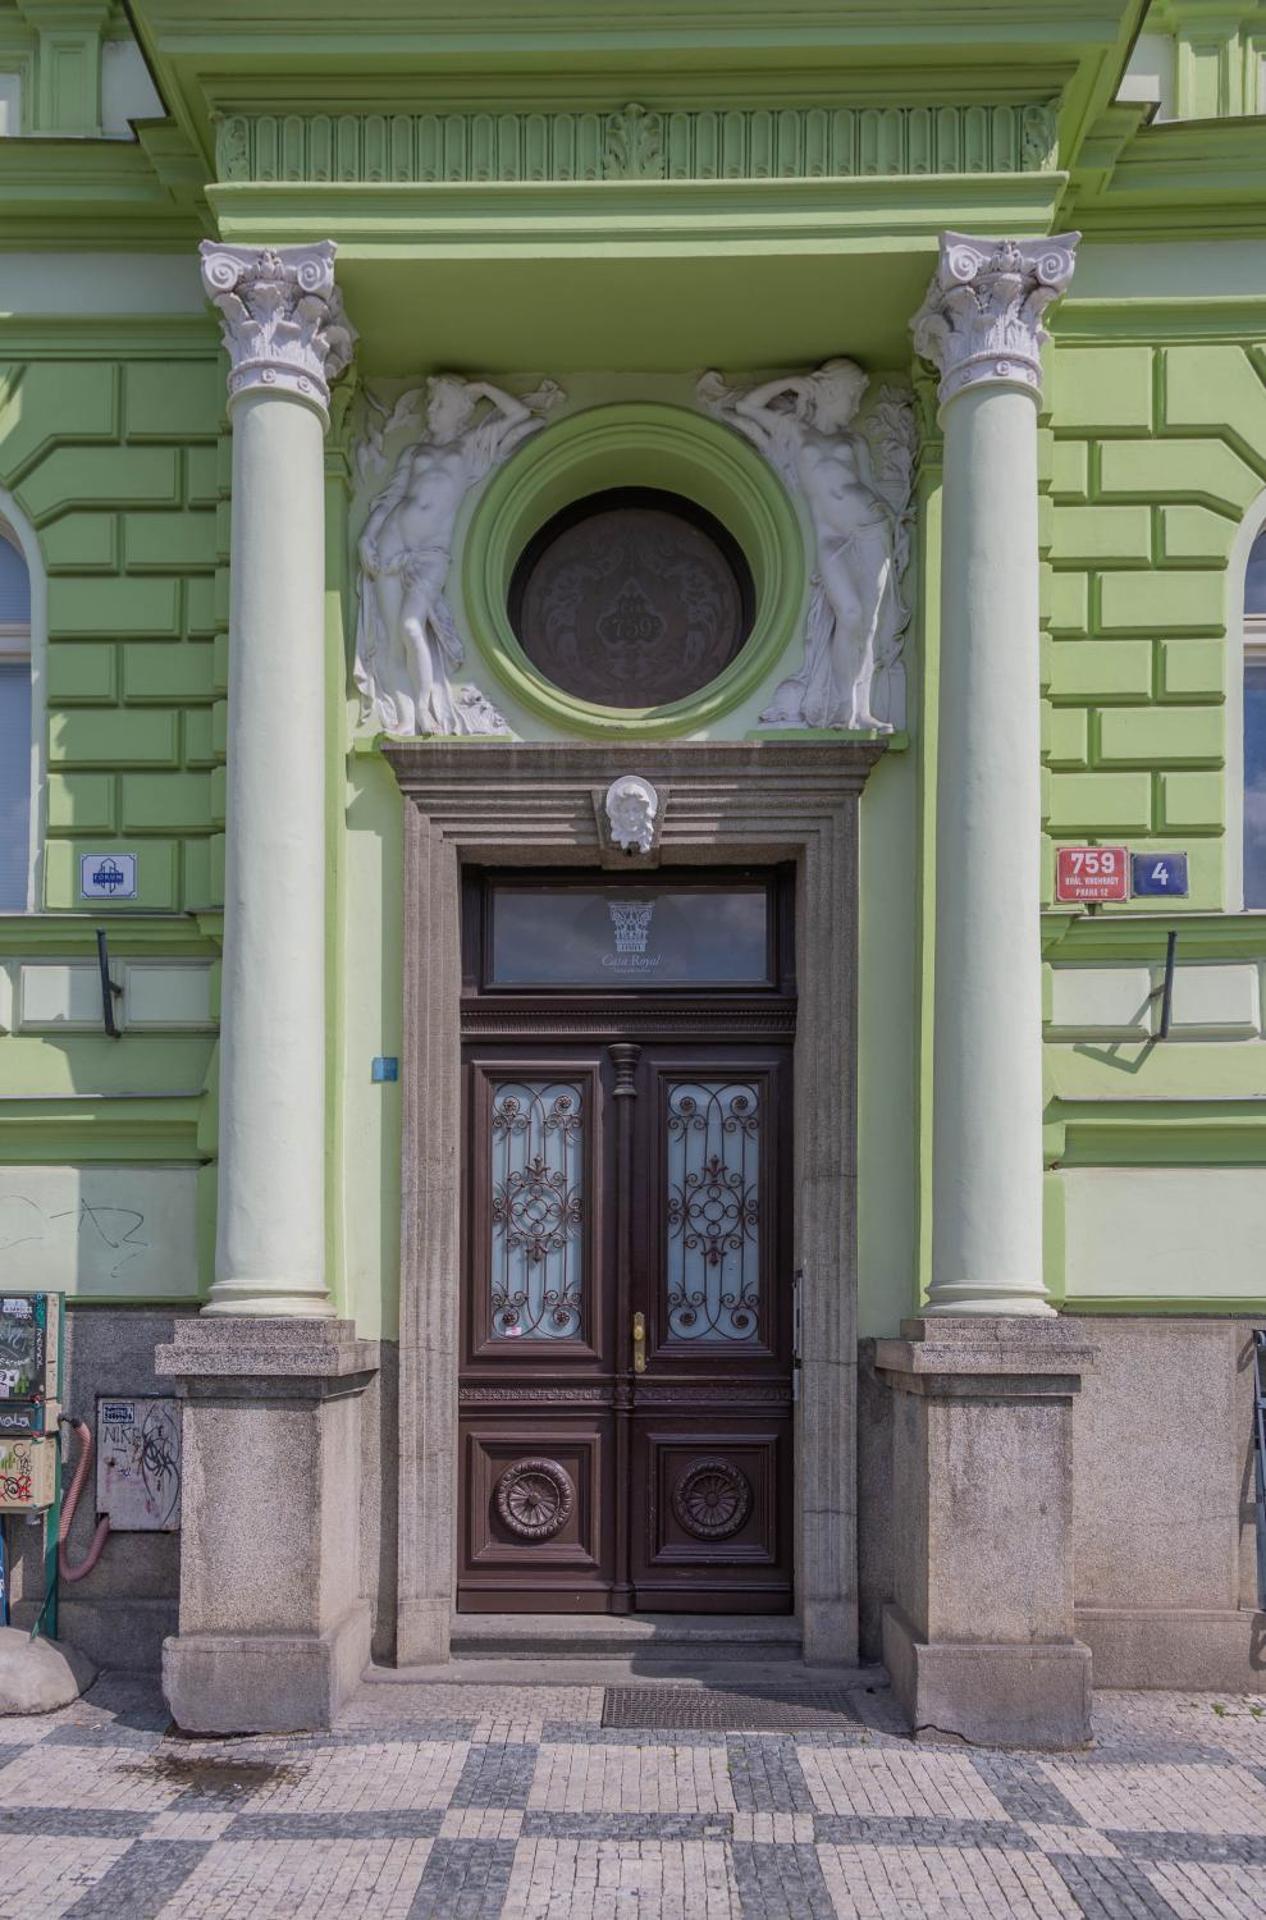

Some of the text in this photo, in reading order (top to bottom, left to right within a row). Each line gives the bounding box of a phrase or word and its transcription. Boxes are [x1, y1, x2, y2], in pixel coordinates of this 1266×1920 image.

[1070, 852, 1115, 874] 759
[1151, 862, 1169, 886] 4
[1075, 888, 1098, 897] PRAHA
[631, 952, 662, 969] Royal
